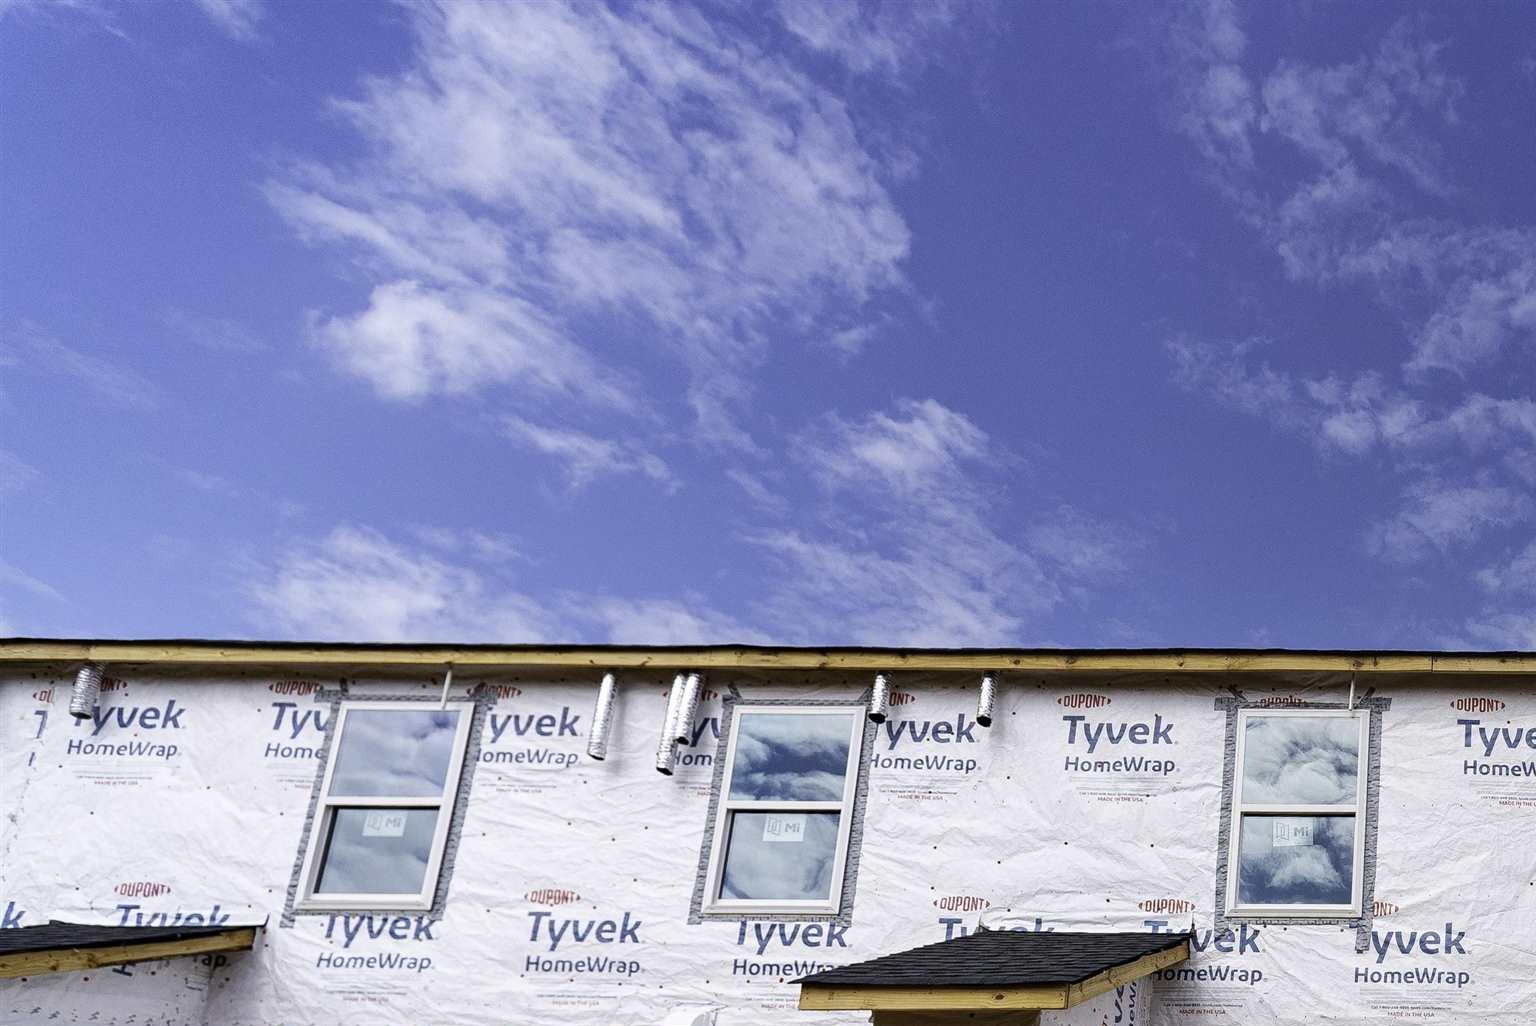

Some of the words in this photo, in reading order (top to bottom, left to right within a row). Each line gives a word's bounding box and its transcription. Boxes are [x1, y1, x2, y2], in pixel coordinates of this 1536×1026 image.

[100, 678, 121, 692] ONT
[275, 682, 320, 696] DUPONT
[889, 692, 910, 706] ONT
[1063, 694, 1106, 708] DUPONT
[1457, 698, 1500, 712] DUPONT
[271, 702, 330, 738] Tyv
[487, 707, 580, 743] yvek
[886, 713, 976, 749] yvek
[1063, 714, 1174, 753] Tyvek
[66, 740, 178, 760] HomeWrap
[1065, 756, 1175, 776] HomeWrap
[120, 884, 165, 897] DUPONT
[530, 890, 577, 904] DUPONT
[940, 897, 985, 911] DUPONT
[1145, 899, 1190, 914] DUPONT
[1373, 902, 1395, 918] ONT
[527, 912, 642, 951] Tyvek
[1352, 923, 1467, 964] yvek
[316, 952, 431, 973] HomeWrap
[526, 956, 640, 976] HomeWrap
[1354, 967, 1470, 988] HomeWrap
